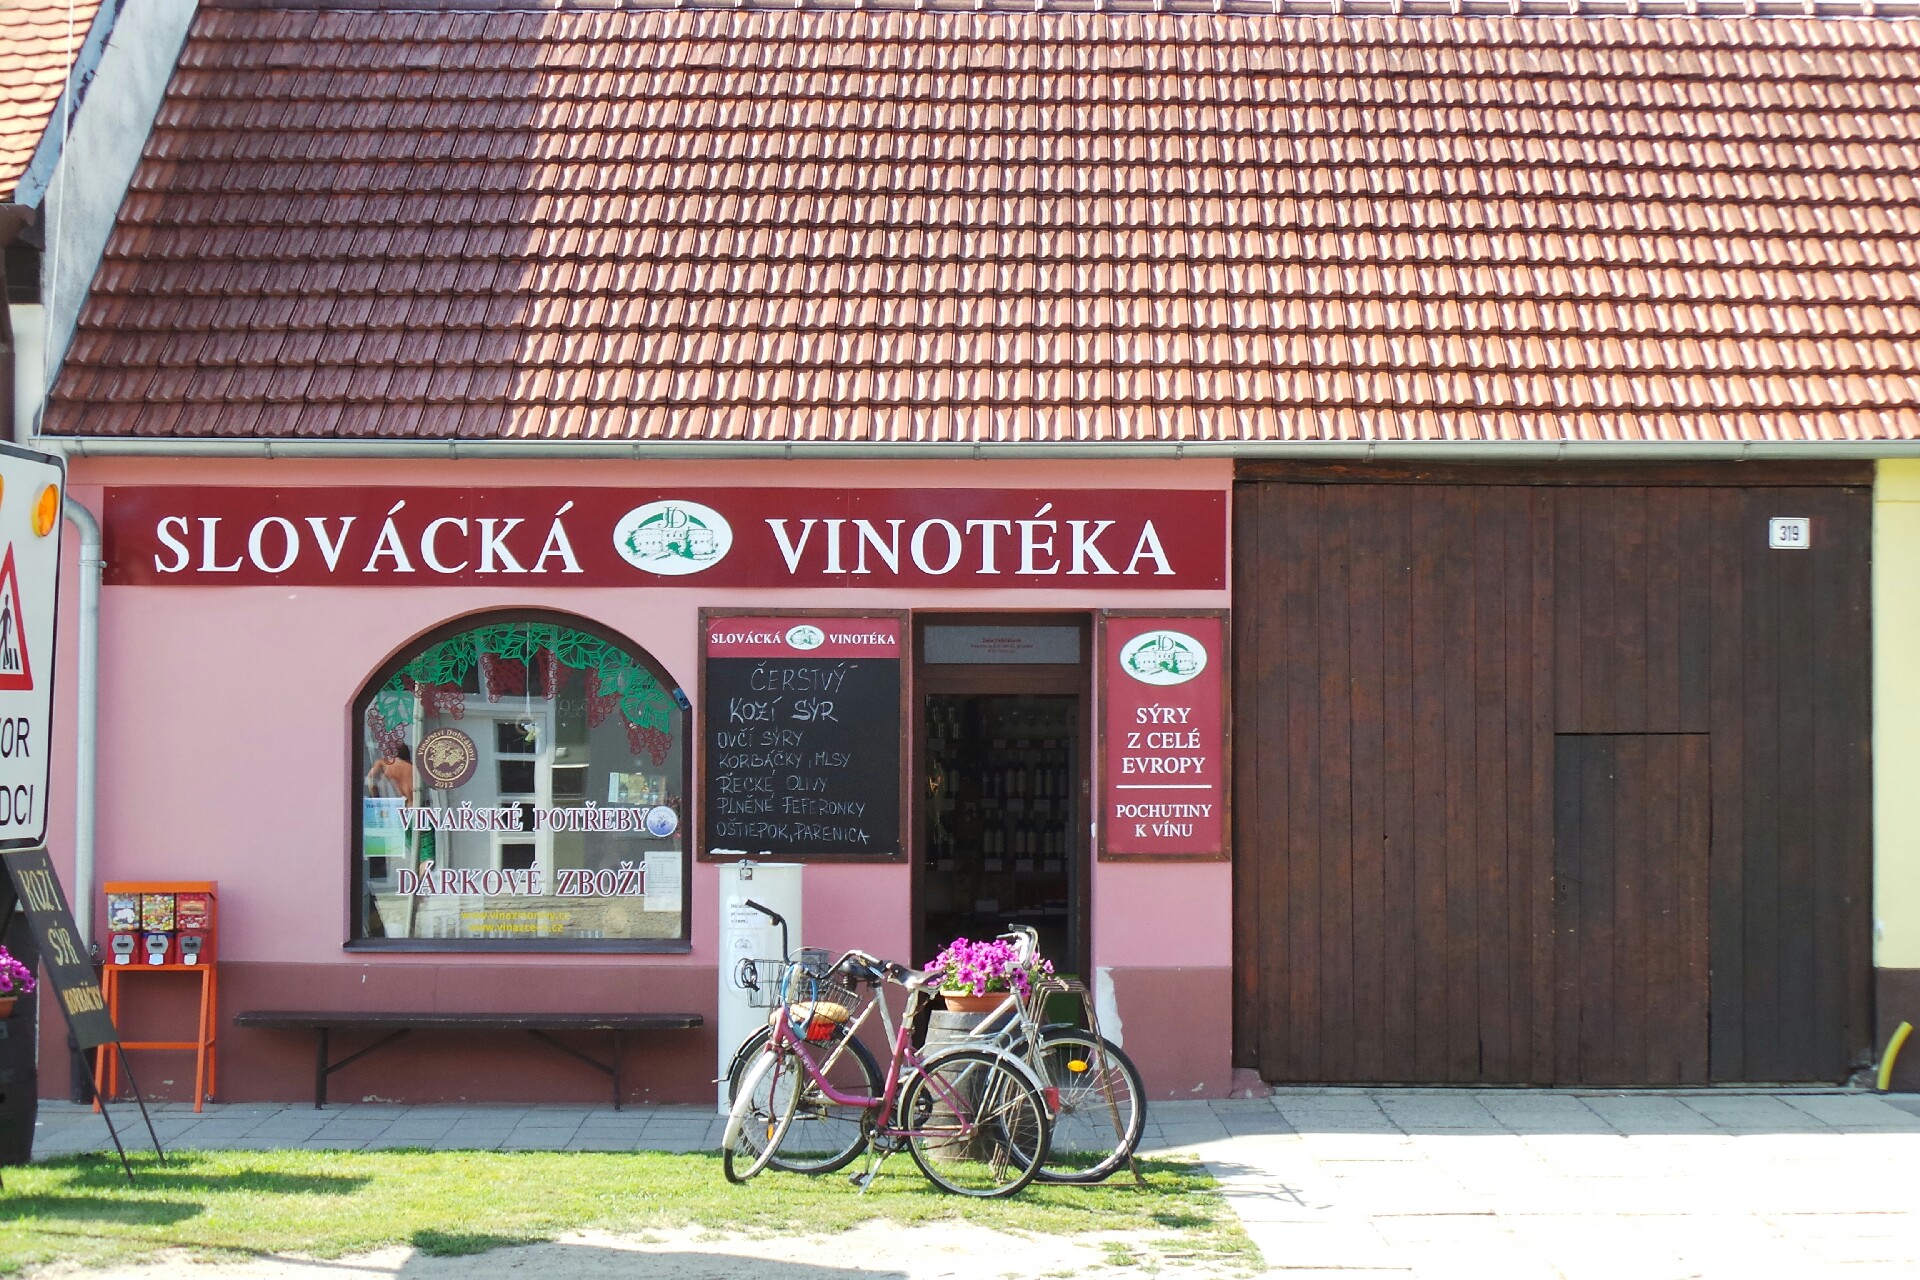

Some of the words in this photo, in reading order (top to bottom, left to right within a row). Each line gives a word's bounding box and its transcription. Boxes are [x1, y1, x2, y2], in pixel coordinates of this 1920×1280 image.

[154, 499, 584, 574] SLOVÁCKÁ
[764, 502, 1176, 576] VINOTÉKA
[1779, 525, 1799, 541] 319
[711, 630, 781, 644] SLOVÁCKÁ
[829, 631, 896, 645] VINOTÉKA
[750, 660, 846, 693] ČERSTVÝ
[729, 696, 782, 724] KOŽÍ
[791, 697, 839, 723] SÝR
[1136, 703, 1192, 724] SÝRY
[0, 717, 30, 758] OR
[717, 726, 755, 748] OVČÍ
[760, 726, 804, 747] SÝRY
[1127, 732, 1141, 749] Z
[1147, 728, 1201, 749] CELÉ
[1121, 757, 1207, 774] EVROPY
[434, 780, 454, 789] 2012
[716, 769, 777, 794] ŘECKÉ
[786, 774, 829, 792] OLIVY
[397, 801, 524, 832] VINAŘSKÉ
[533, 801, 649, 832] POTŘEBY
[782, 796, 866, 818] FEFERONKY
[1116, 804, 1212, 818] POCHUTINY
[1135, 823, 1147, 837] K
[1152, 820, 1193, 838] VÍNU
[396, 861, 543, 897] DÁRKOVÉ
[557, 861, 648, 897] ZBOŽÍ
[48, 919, 80, 966] SÝR
